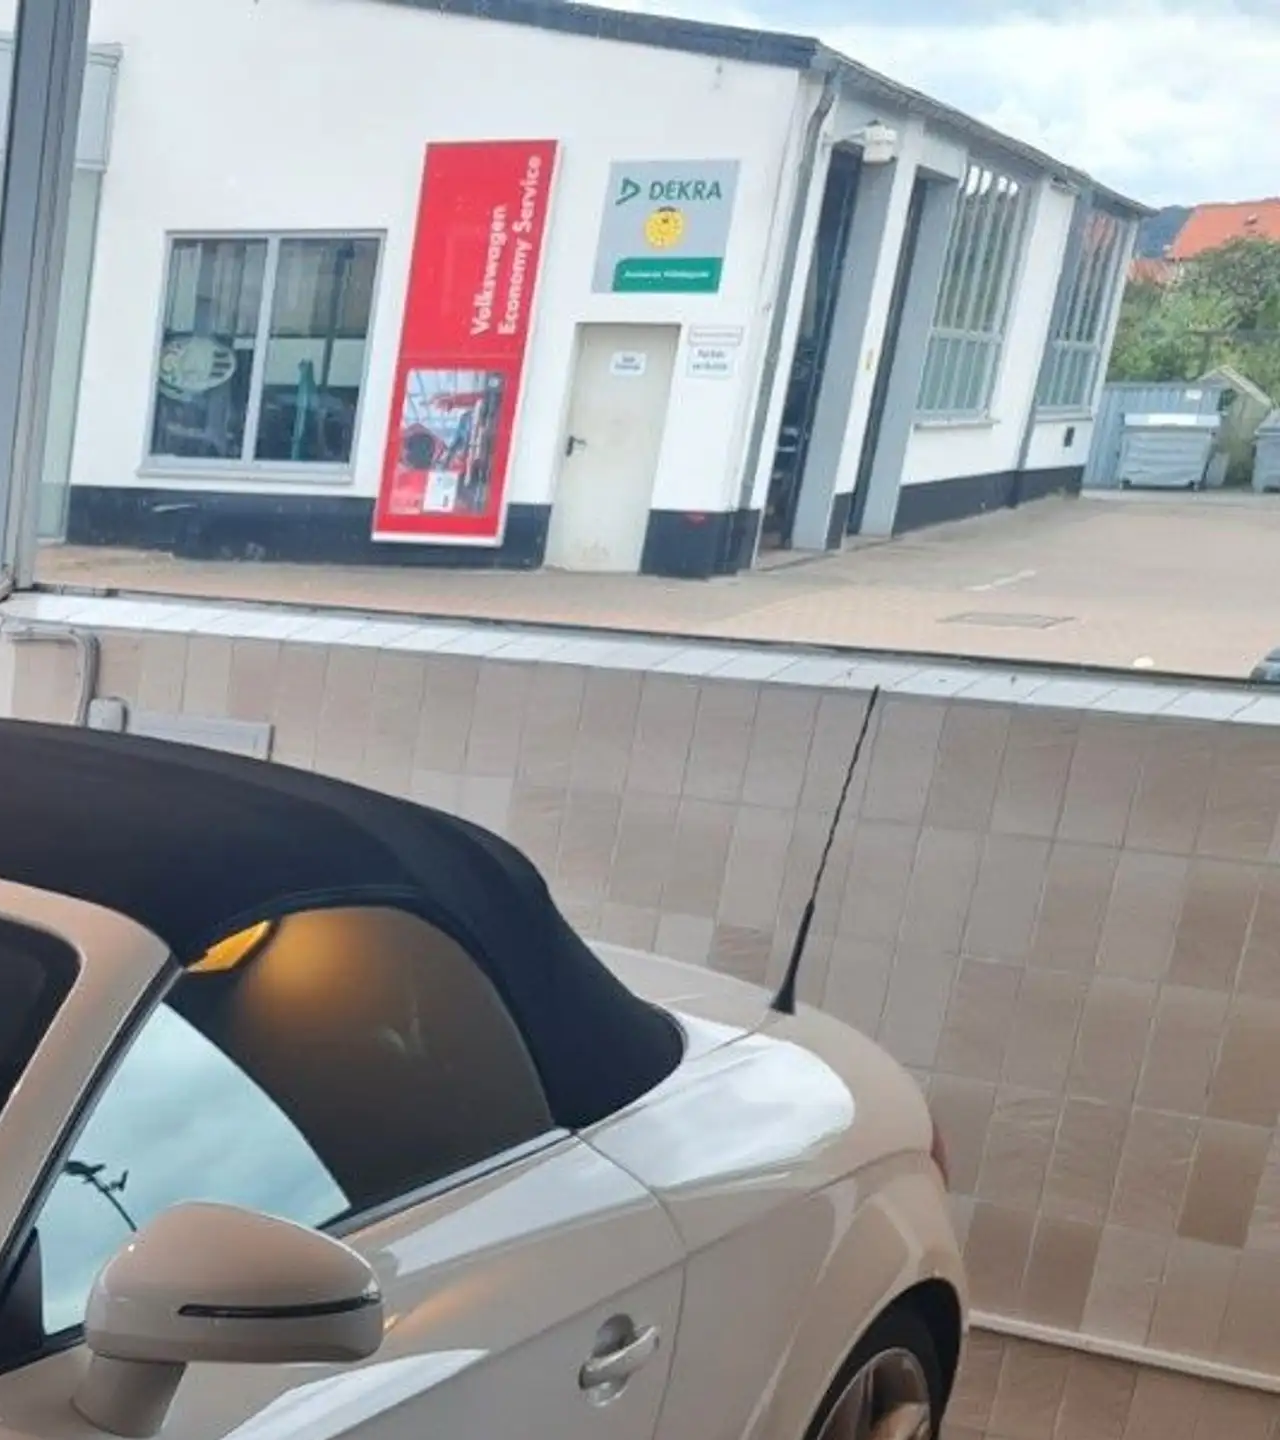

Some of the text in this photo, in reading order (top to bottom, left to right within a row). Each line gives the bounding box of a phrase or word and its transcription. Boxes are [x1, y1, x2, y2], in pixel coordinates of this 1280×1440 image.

[497, 155, 542, 336] Economy Service
[648, 179, 722, 201] DEKRA
[470, 203, 508, 336] Volkswagen
